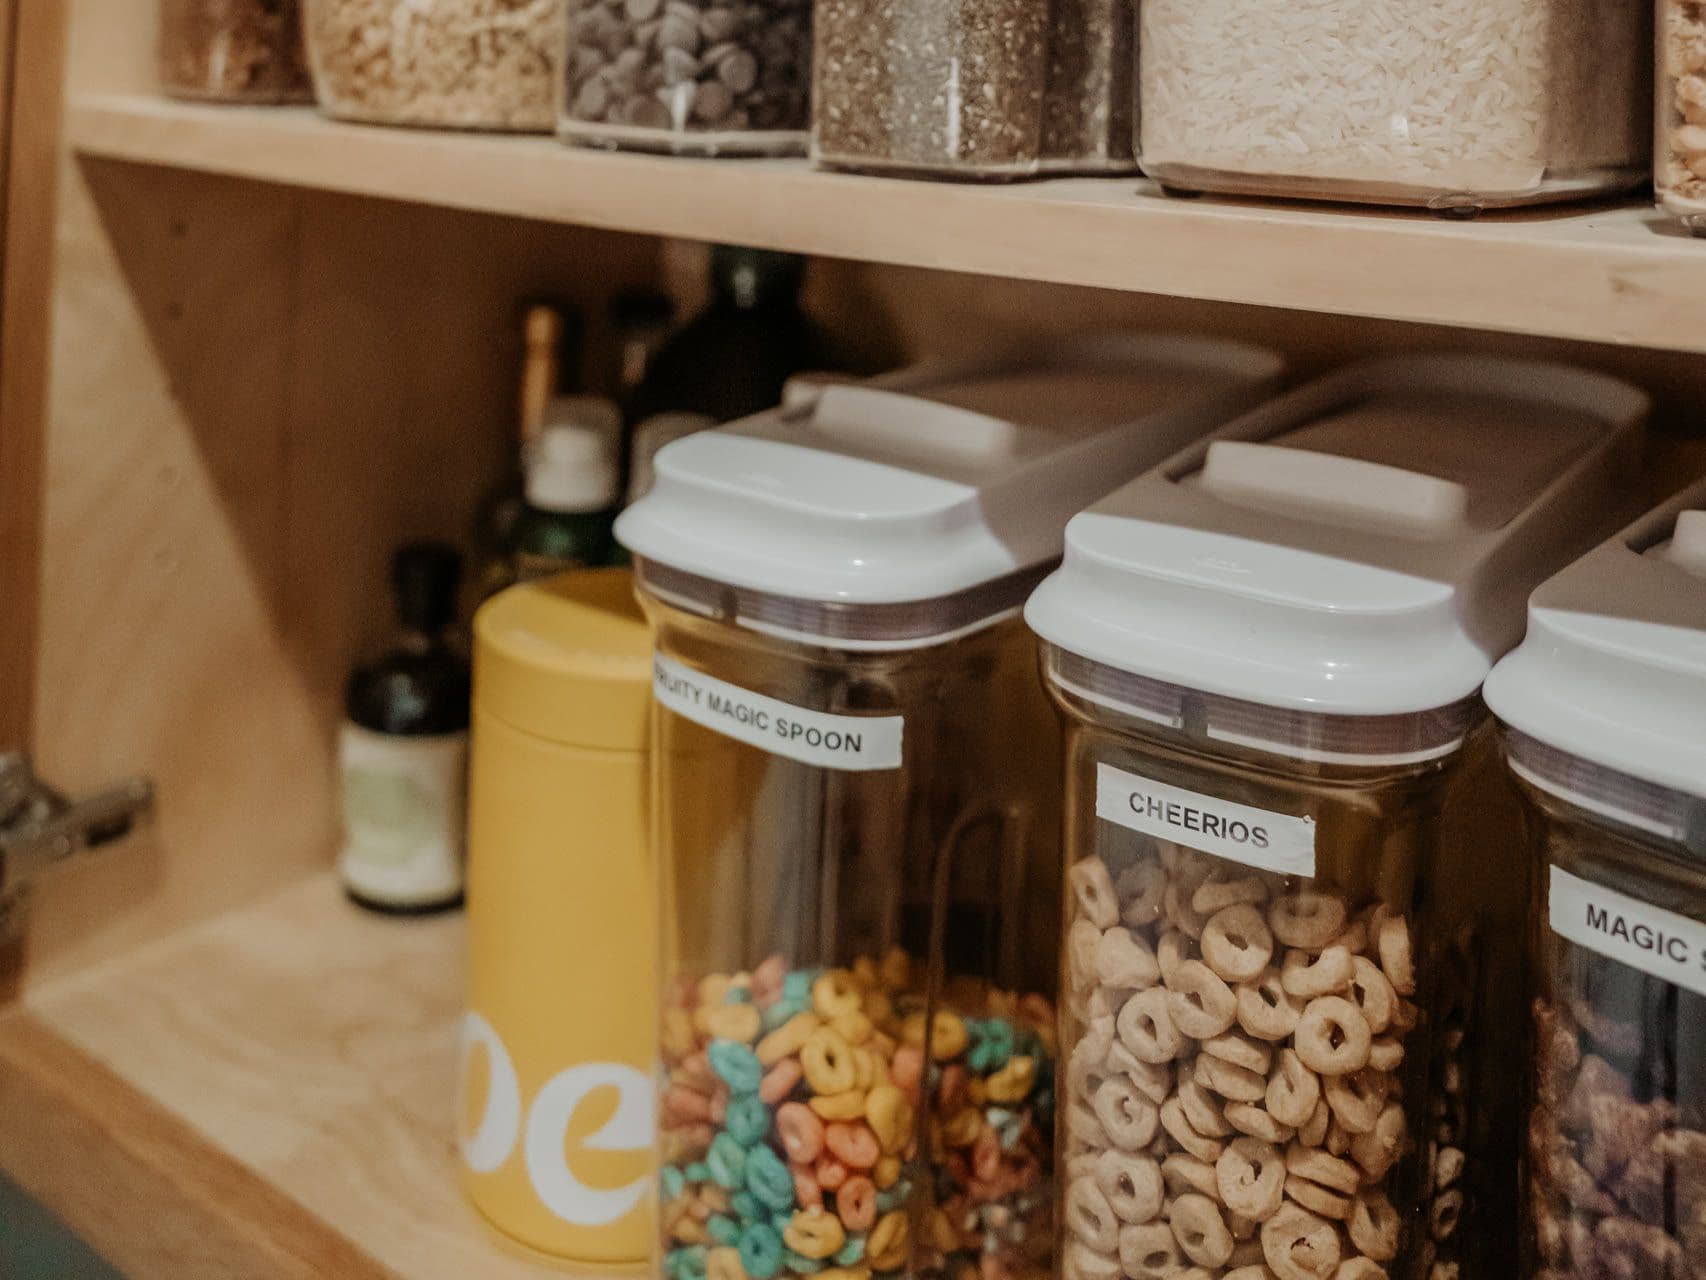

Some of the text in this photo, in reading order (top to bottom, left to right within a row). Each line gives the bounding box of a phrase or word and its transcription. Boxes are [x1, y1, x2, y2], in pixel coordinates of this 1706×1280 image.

[708, 692, 769, 731] MAGIC
[776, 718, 863, 753] SPOON
[1129, 791, 1270, 849] CHEERIOS
[1586, 903, 1689, 963] MAGIC
